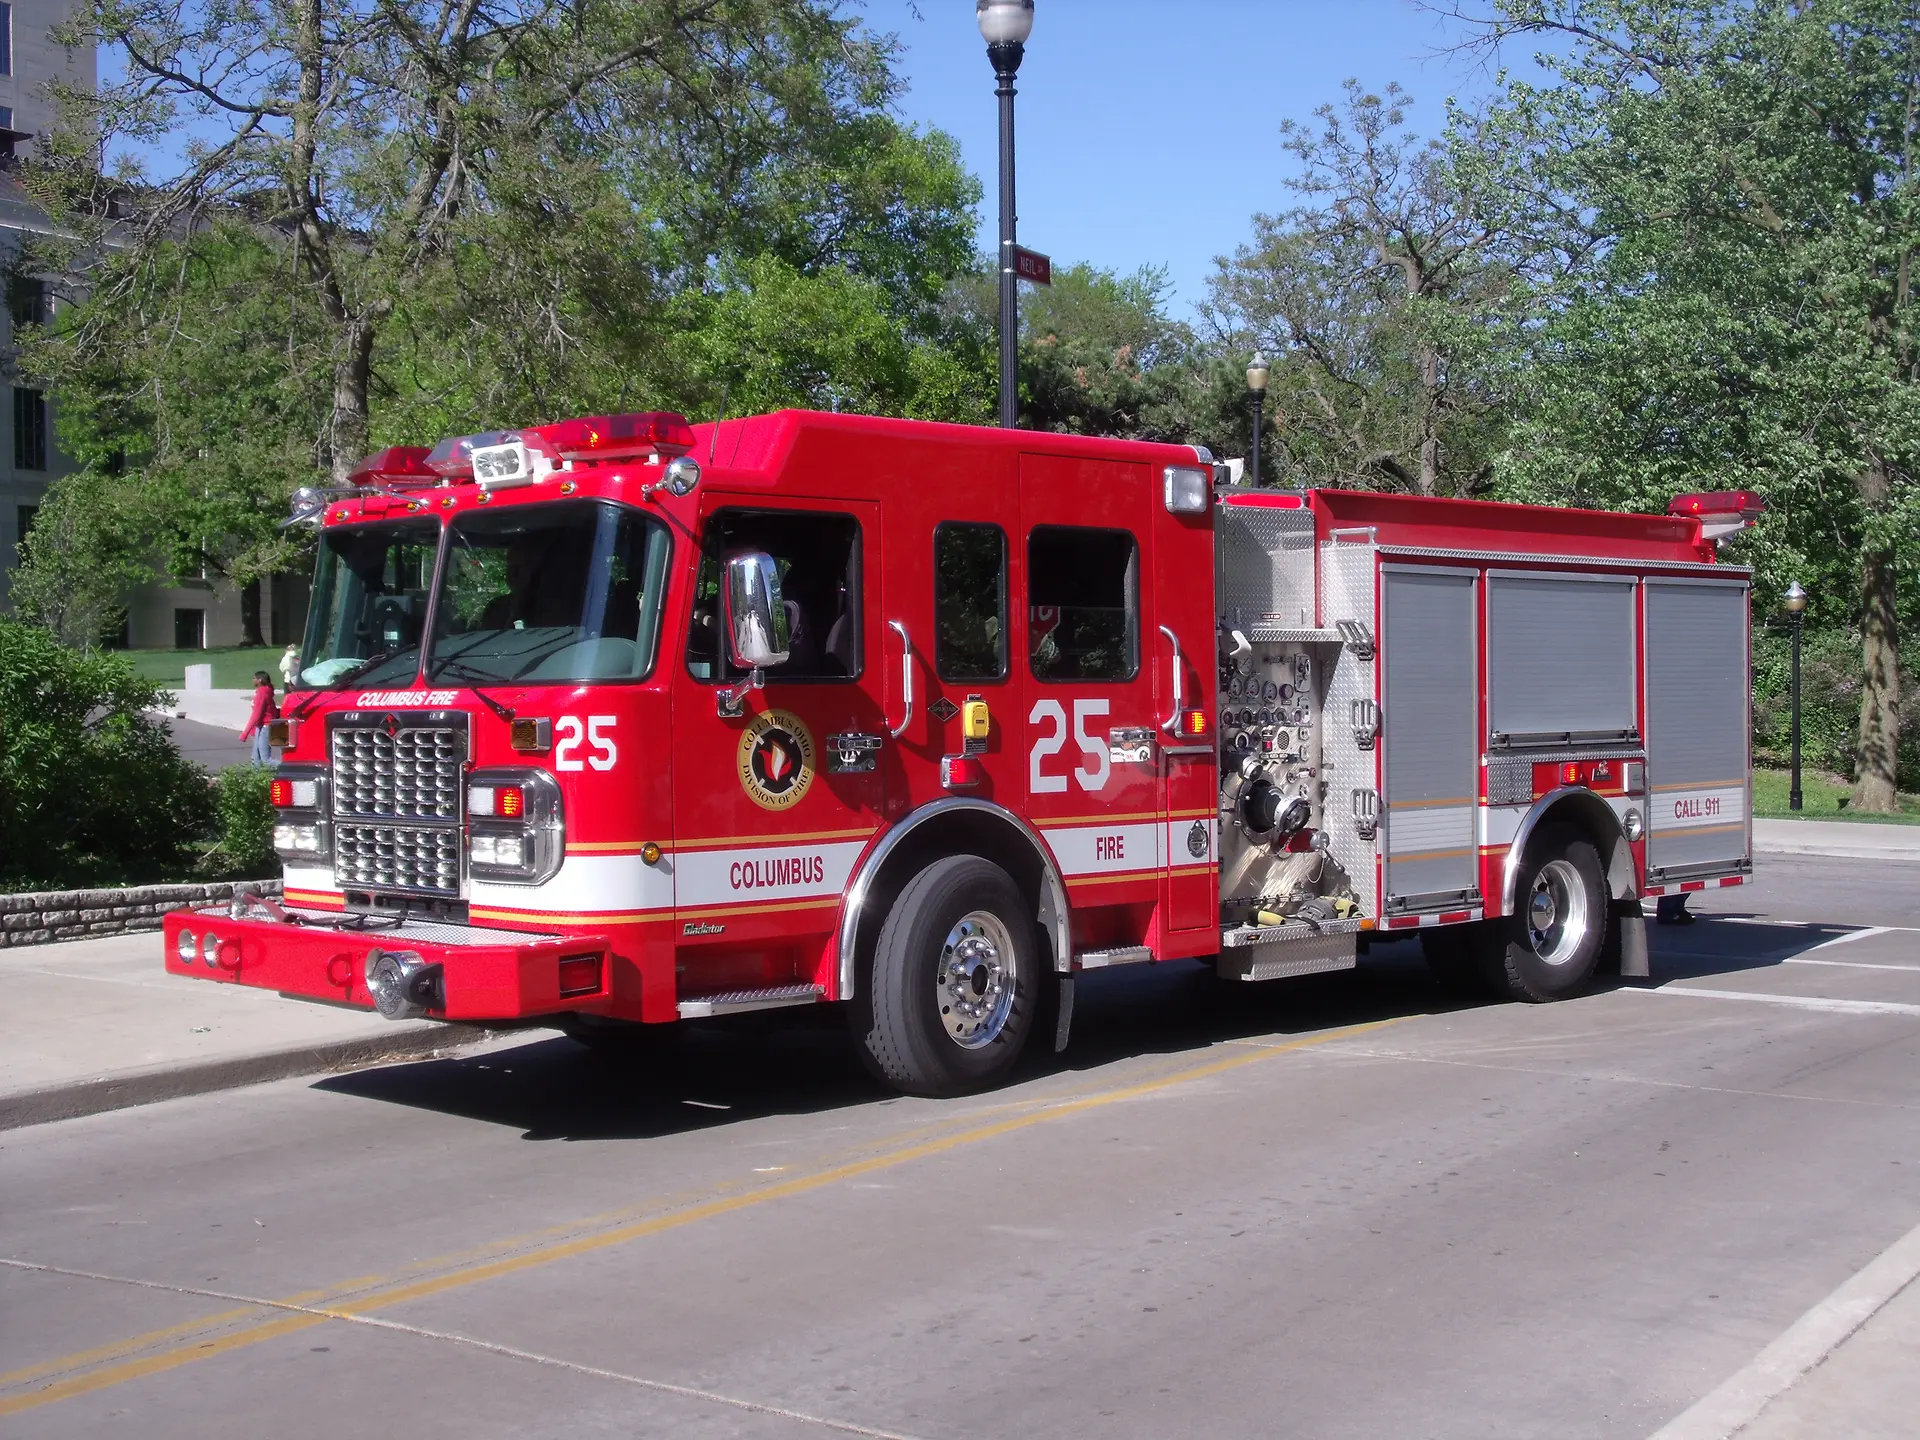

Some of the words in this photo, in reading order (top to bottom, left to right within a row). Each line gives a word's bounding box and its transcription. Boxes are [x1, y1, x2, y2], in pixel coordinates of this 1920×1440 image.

[1020, 256, 1037, 276] NEIL
[356, 691, 428, 707] COLUMBUS
[424, 690, 459, 705] FIRE
[555, 715, 617, 771] 25
[744, 716, 793, 751] COLUMBUS
[794, 726, 812, 758] OHIO
[1029, 698, 1110, 793] 25
[743, 764, 775, 805] DIVISION
[778, 794, 792, 805] OF
[793, 770, 810, 797] FIRE
[1674, 799, 1702, 819] CALL
[1705, 797, 1720, 816] 911
[1096, 835, 1124, 860] FIRE
[729, 855, 824, 890] COLUMBUS
[682, 921, 725, 936] Gladiator
